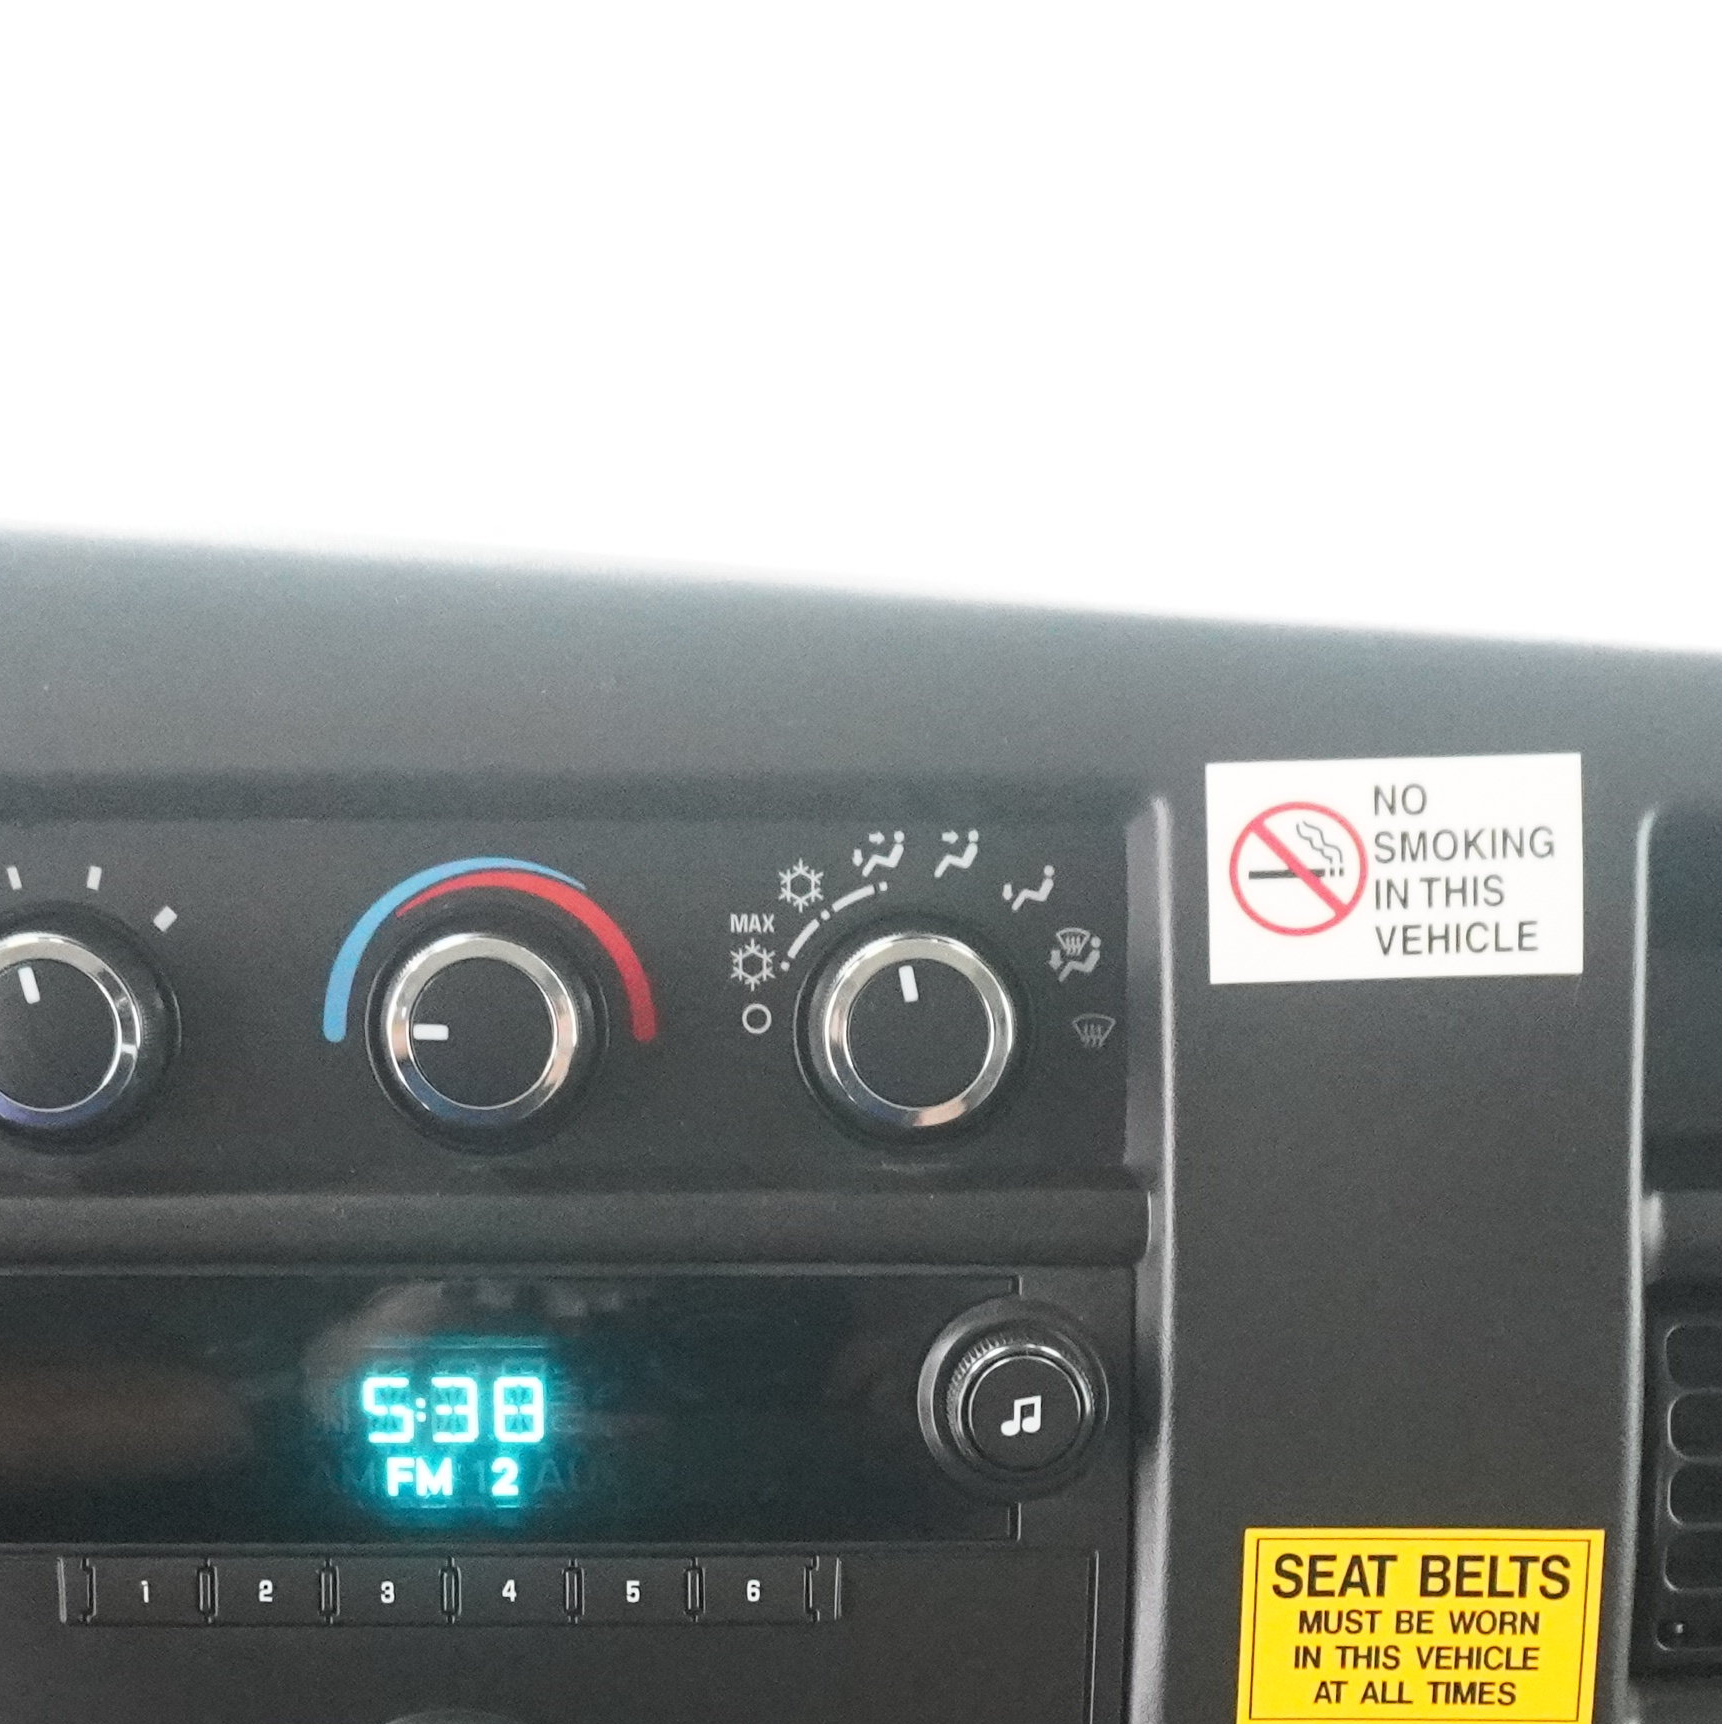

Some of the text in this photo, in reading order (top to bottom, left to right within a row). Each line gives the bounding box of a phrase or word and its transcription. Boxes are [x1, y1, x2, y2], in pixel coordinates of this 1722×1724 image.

[1373, 783, 1427, 816] NO
[1374, 826, 1555, 865] SMOKING
[1375, 874, 1505, 910] IN THIS
[730, 913, 775, 934] MAX
[1375, 920, 1538, 956] VEHICLE
[361, 1376, 545, 1444] 5:38
[386, 1456, 454, 1497] FM
[491, 1456, 520, 1497] 2
[1271, 1552, 1571, 1601] SEAT BELTS
[140, 1580, 150, 1603] 1
[258, 1579, 273, 1603] 2
[380, 1580, 395, 1604] 3
[501, 1579, 517, 1602] 4
[626, 1580, 640, 1603] 5
[746, 1579, 761, 1602] 6
[1298, 1608, 1540, 1636] MUST BE WORN
[1294, 1644, 1540, 1671] IN THIS VEHICLE
[1313, 1680, 1516, 1707] AT ALL TIMES
